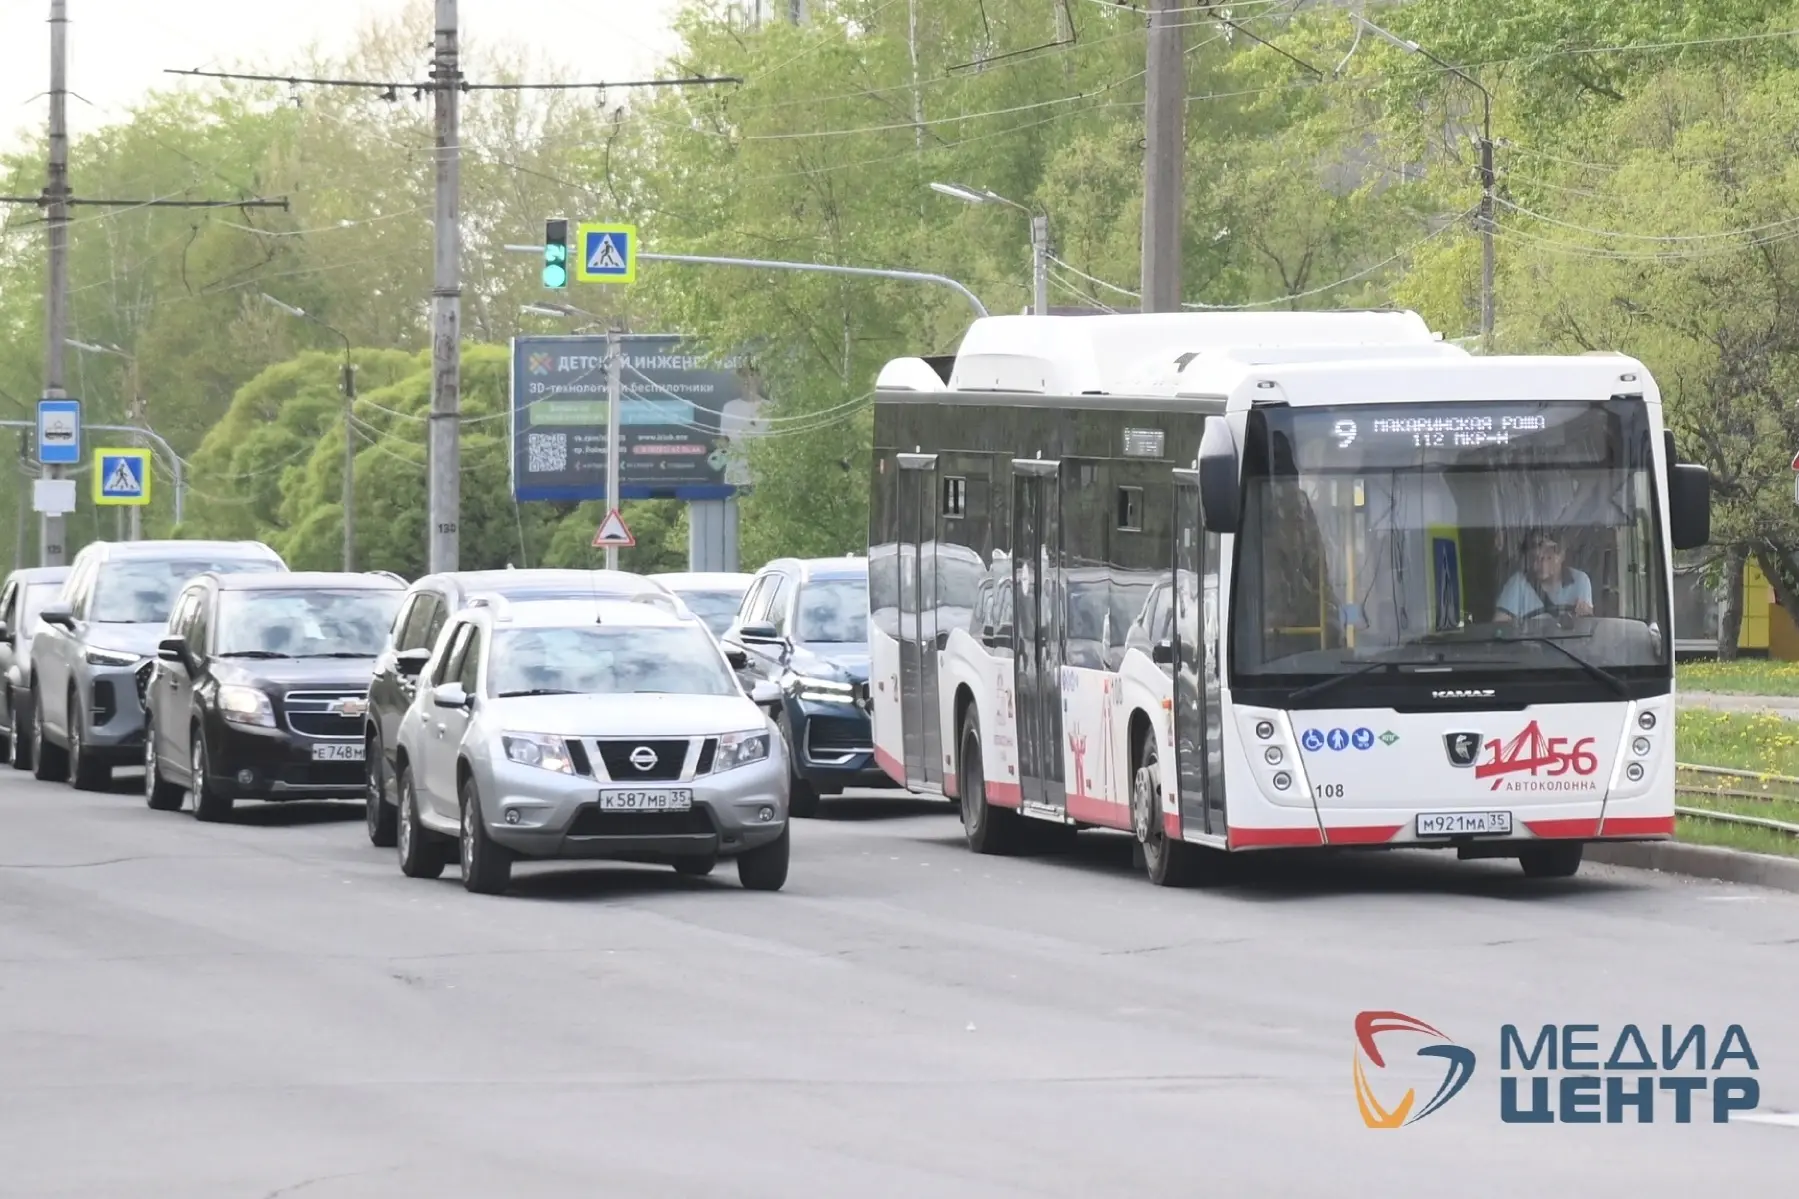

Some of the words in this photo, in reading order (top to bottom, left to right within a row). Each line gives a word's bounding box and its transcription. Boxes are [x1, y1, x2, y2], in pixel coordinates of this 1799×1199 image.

[558, 353, 630, 372] ДЕТСКЙ
[529, 383, 610, 394] 3D-технологи
[1334, 419, 1358, 448] 9
[1373, 415, 1493, 433] МАКАРИНСКАЯ
[1413, 431, 1445, 447] 112
[1432, 689, 1495, 698] KAMAZ
[317, 745, 366, 759] Е748М
[1315, 783, 1345, 799] 108
[1505, 780, 1597, 792] АВТОКОЛОННА
[605, 792, 667, 808] К587МВ
[671, 791, 686, 803] 35
[1423, 815, 1486, 831] М921МА
[1490, 814, 1505, 826] 35
